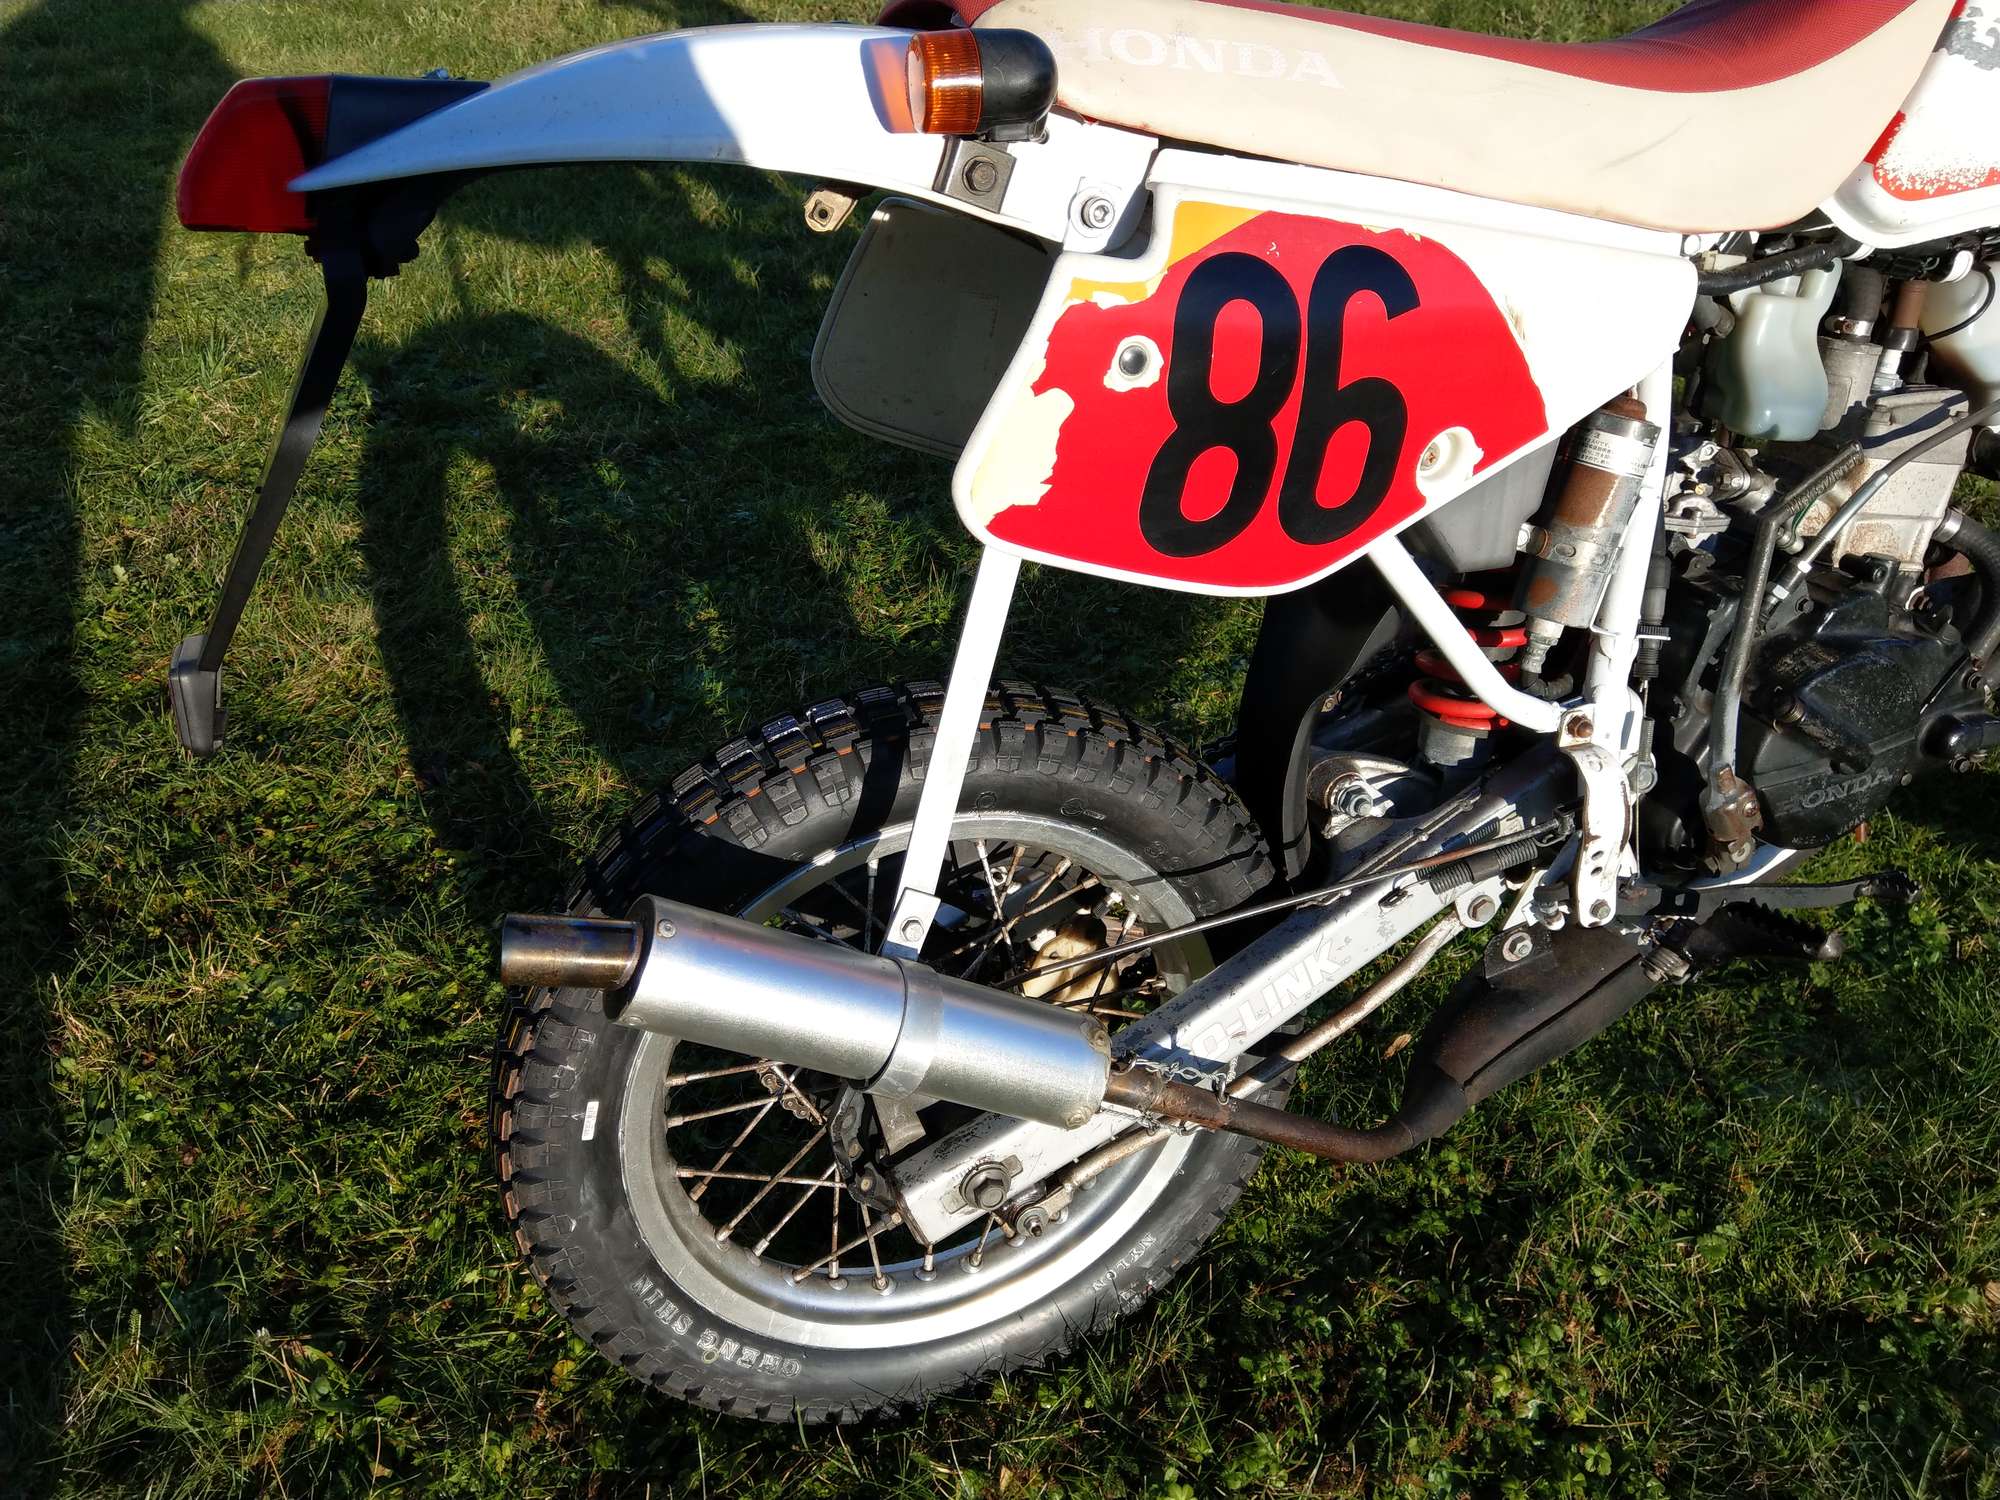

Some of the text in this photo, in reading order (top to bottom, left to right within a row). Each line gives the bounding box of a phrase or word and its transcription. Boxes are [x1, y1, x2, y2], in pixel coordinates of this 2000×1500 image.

[1138, 244, 1421, 558] 86
[632, 1272, 802, 1378] CHENG SHIN
